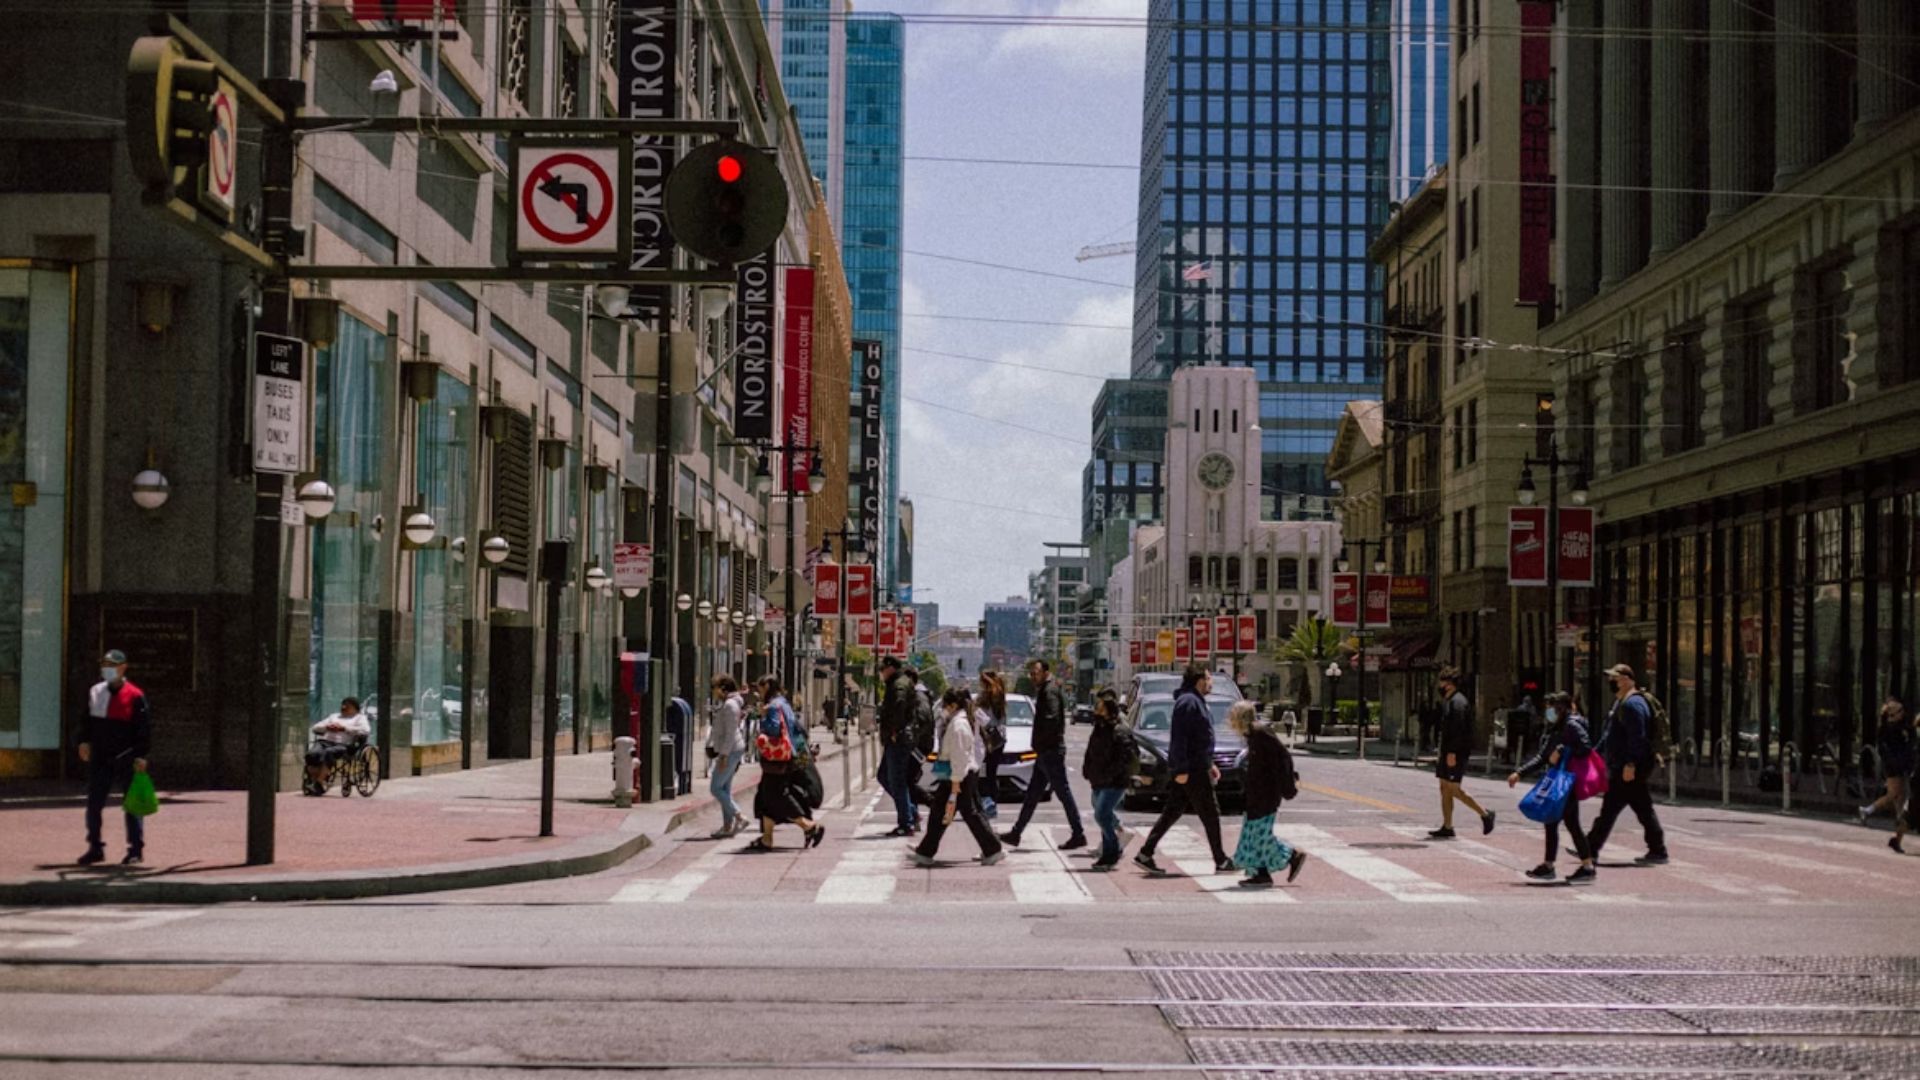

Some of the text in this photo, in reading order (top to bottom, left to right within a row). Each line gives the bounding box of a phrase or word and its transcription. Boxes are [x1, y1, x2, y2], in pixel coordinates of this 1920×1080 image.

[799, 315, 810, 347] CENTRE
[270, 360, 290, 374] LANE
[798, 348, 809, 396] FRANCISCO
[264, 380, 294, 399] BUSES
[266, 404, 291, 422] TAXIS
[798, 396, 808, 414] SAN
[266, 427, 290, 444] ONLY
[863, 344, 880, 553] HOTEL PICKW
